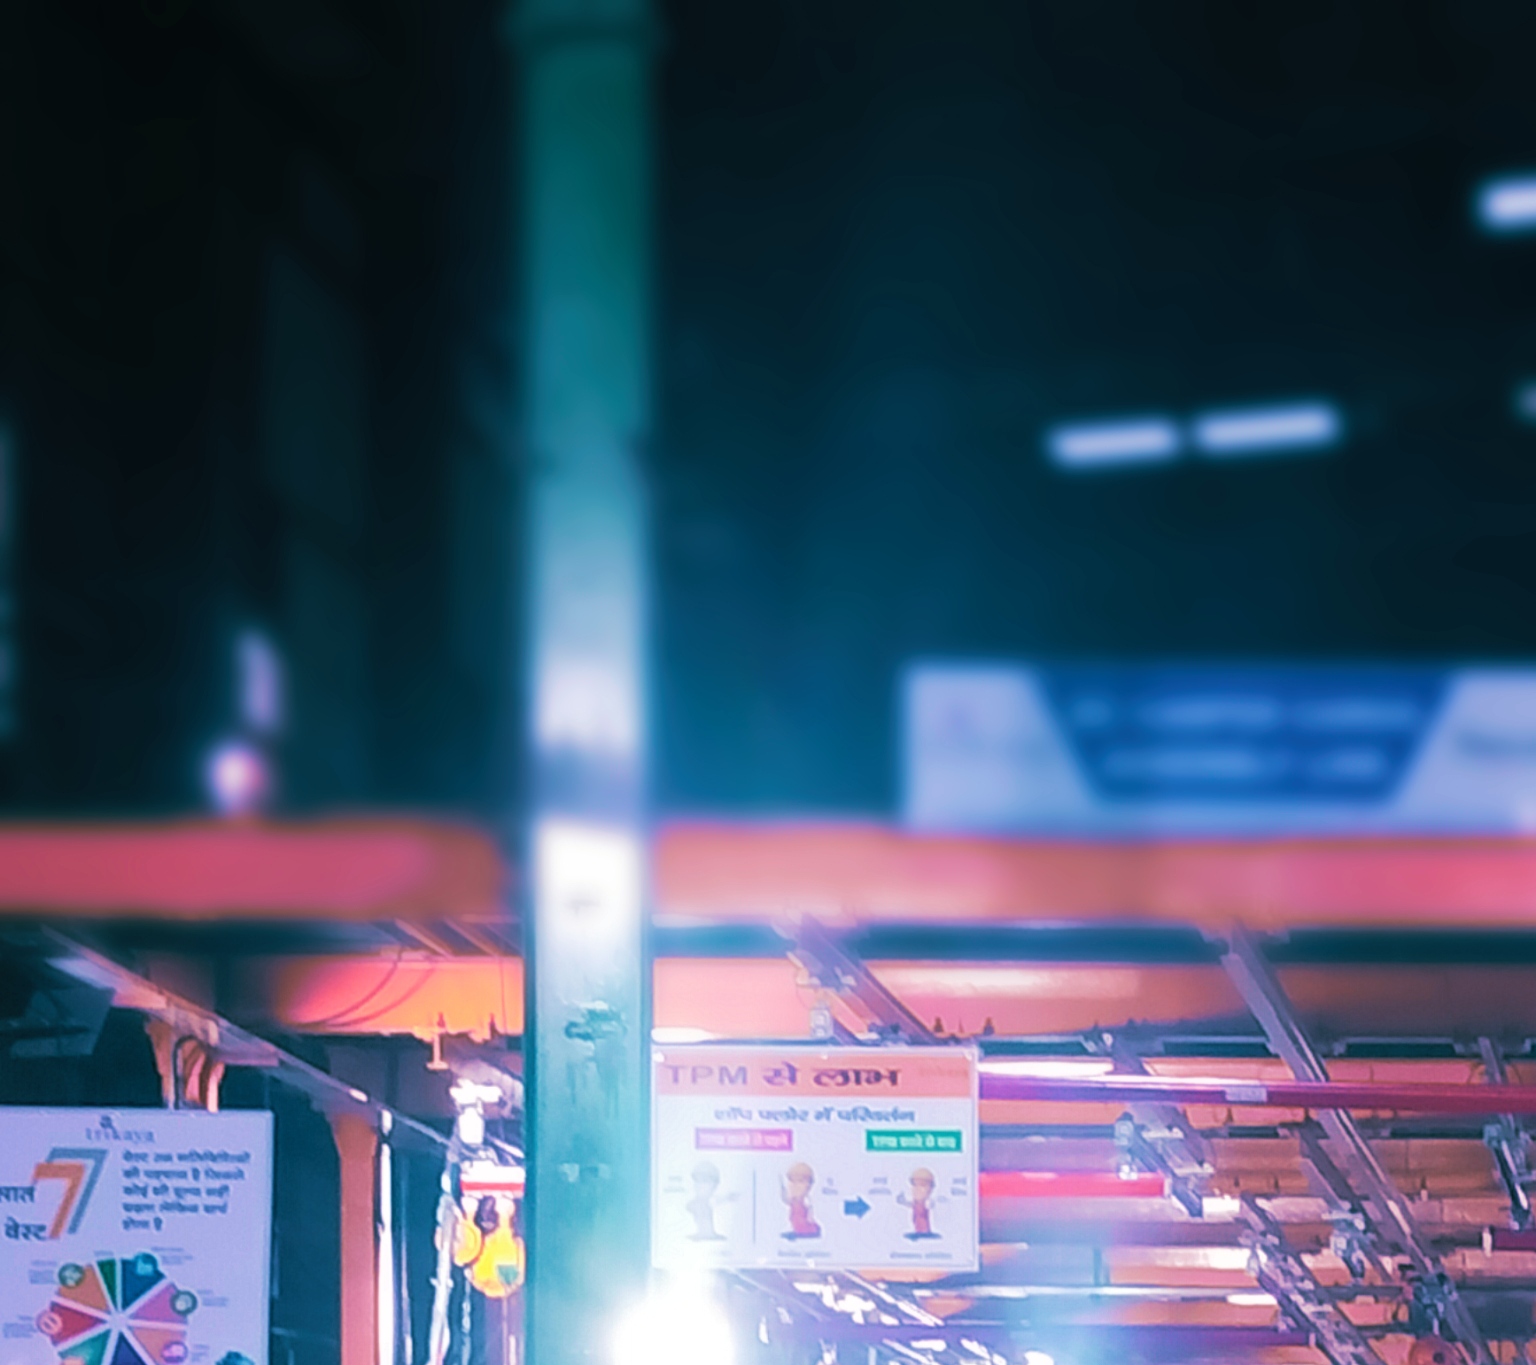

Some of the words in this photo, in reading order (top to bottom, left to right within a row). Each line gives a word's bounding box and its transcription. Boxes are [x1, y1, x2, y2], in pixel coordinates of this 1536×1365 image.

[666, 1064, 748, 1086] TPM
[763, 1061, 799, 1086] से
[812, 1067, 901, 1087] लाभ
[4, 1216, 47, 1240] वेस्ट
